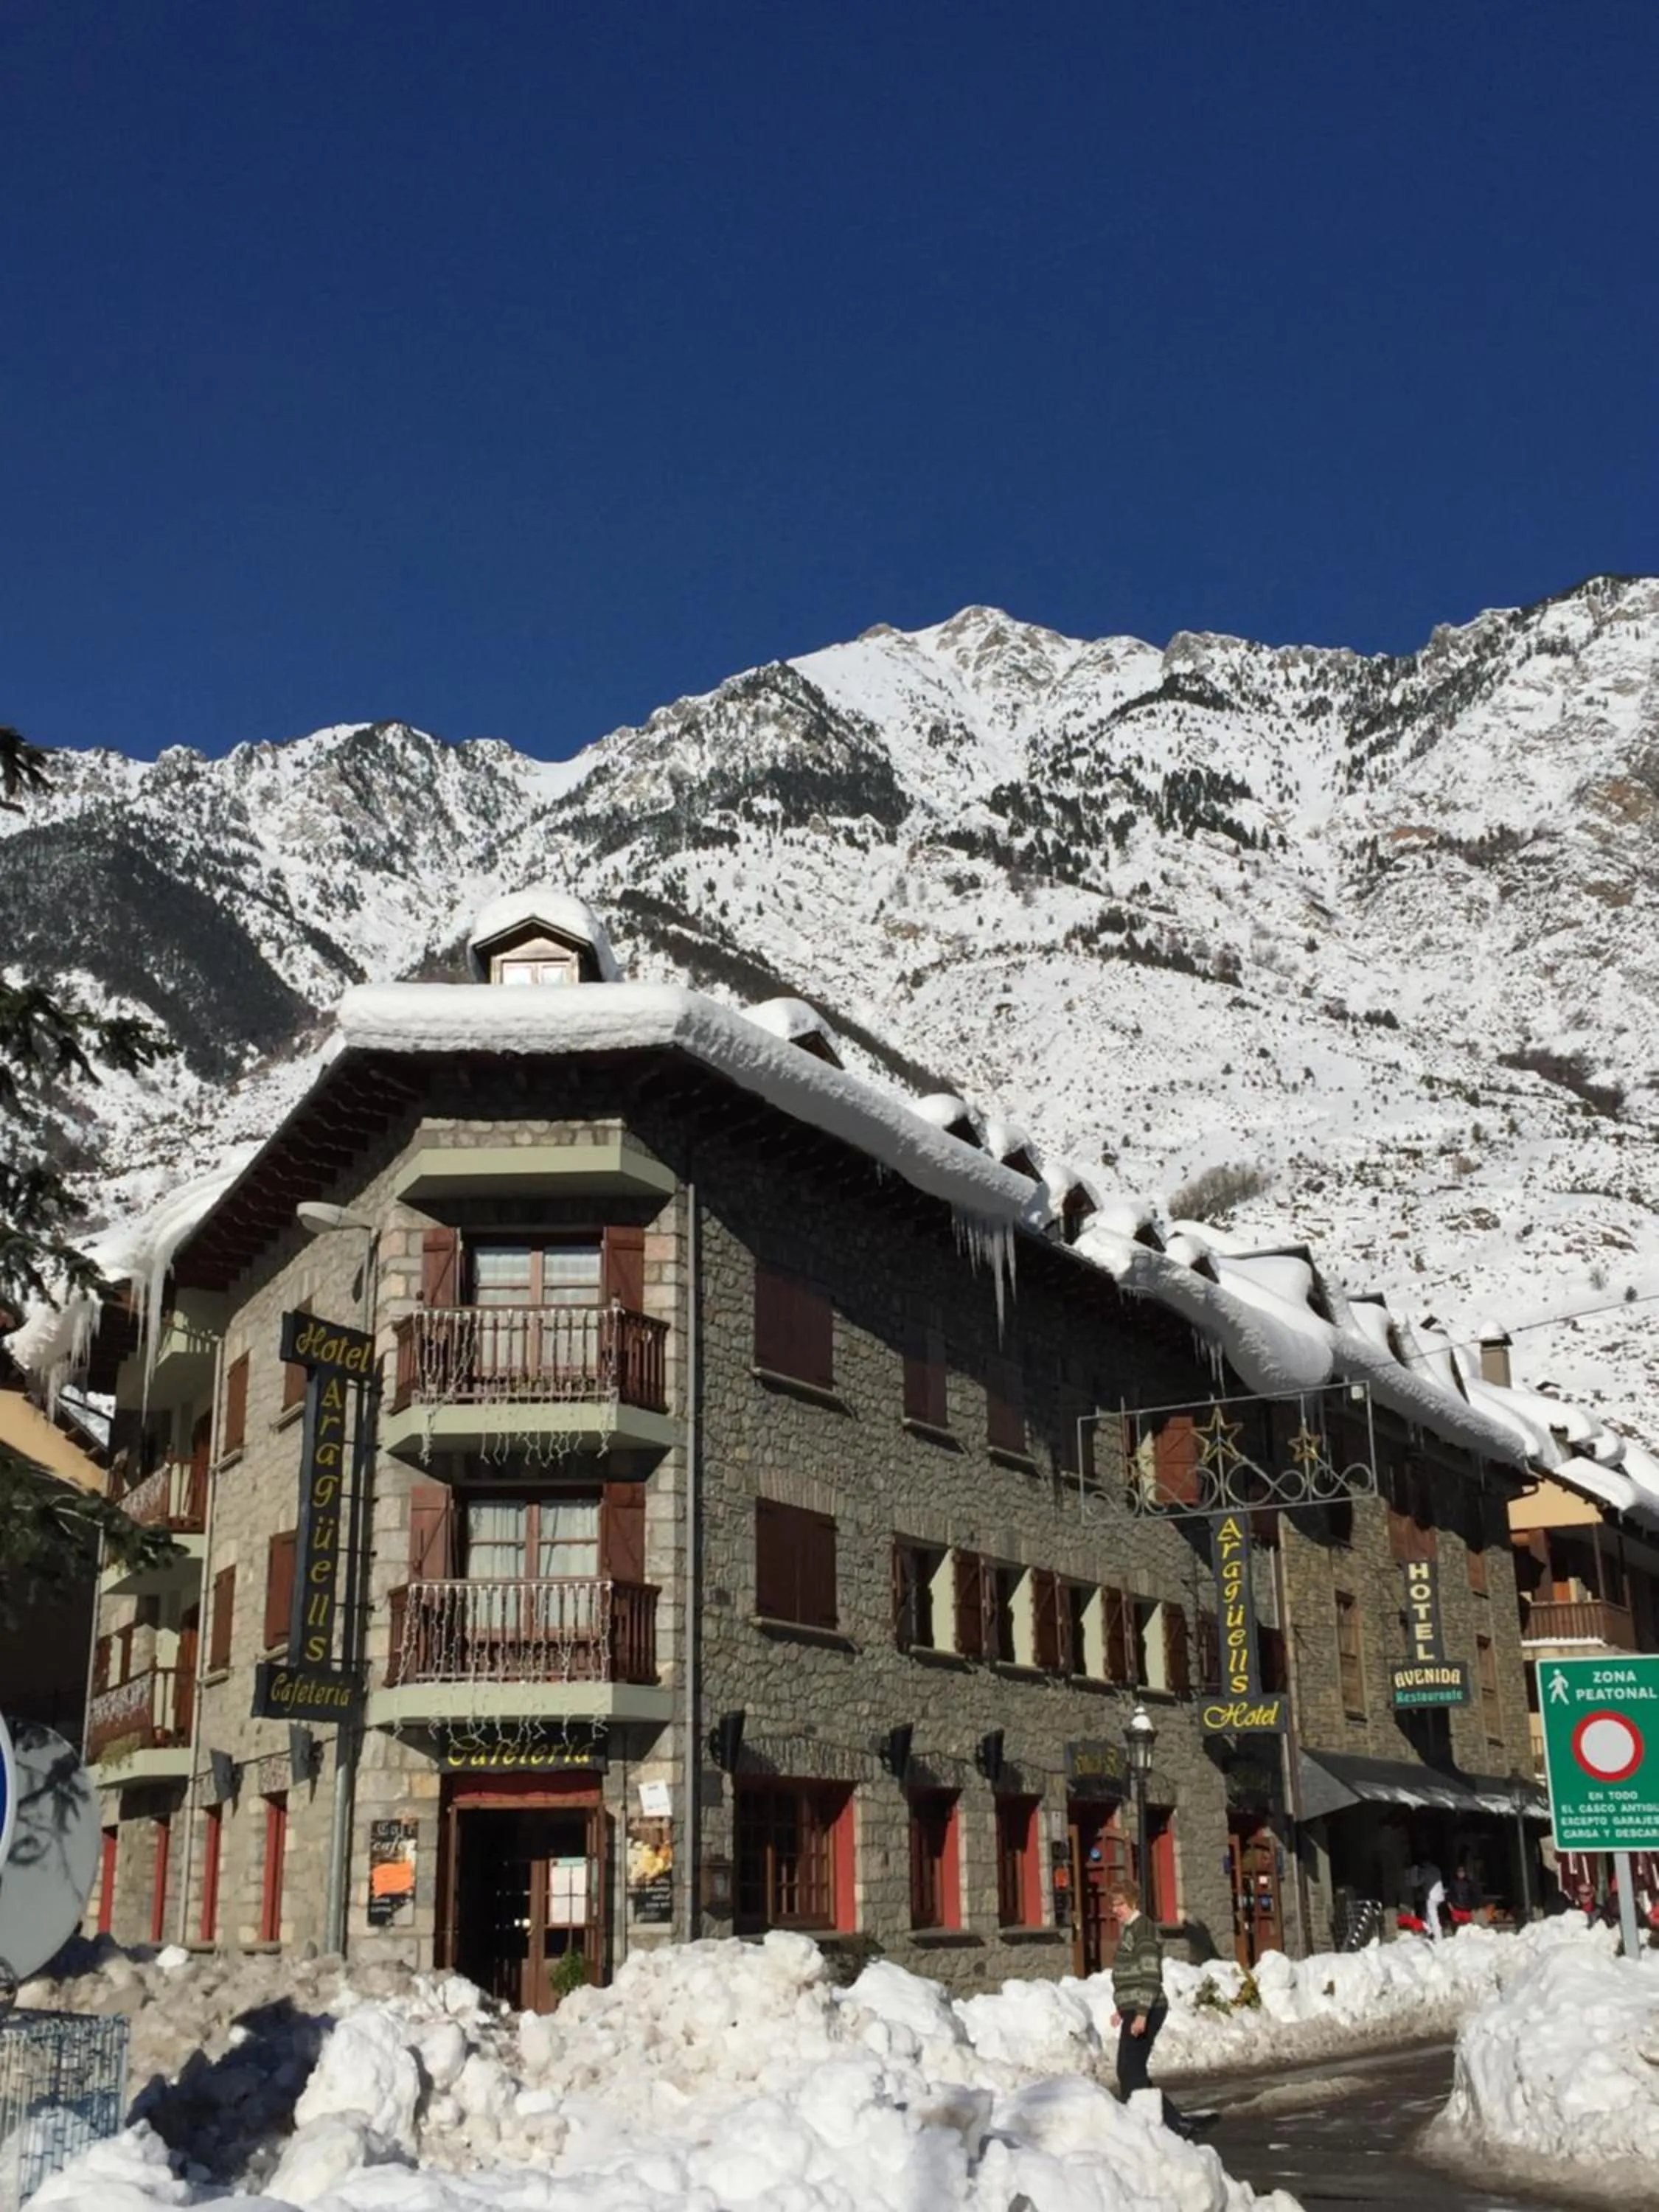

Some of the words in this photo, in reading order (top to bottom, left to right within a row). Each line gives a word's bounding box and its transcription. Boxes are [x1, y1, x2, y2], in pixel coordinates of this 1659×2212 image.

[296, 1321, 370, 1374] Hotel
[305, 1377, 343, 1663] Aragüells
[1217, 1517, 1249, 1693] Aragüells
[1408, 1562, 1435, 1660] HOTEL
[1395, 1668, 1461, 1688] AVENIDA
[1593, 1671, 1636, 1683] ZONA
[1576, 1687, 1657, 1700] PEATONAL
[1203, 1701, 1279, 1728] Hotel
[1588, 1791, 1604, 1801] EN
[1608, 1790, 1638, 1800] TODO
[1561, 1804, 1574, 1814] EL
[1579, 1804, 1616, 1814] CASCO
[1561, 1816, 1607, 1826] EXCEPTO
[1563, 1829, 1600, 1839] CARGA
[1603, 1829, 1610, 1838] Y
